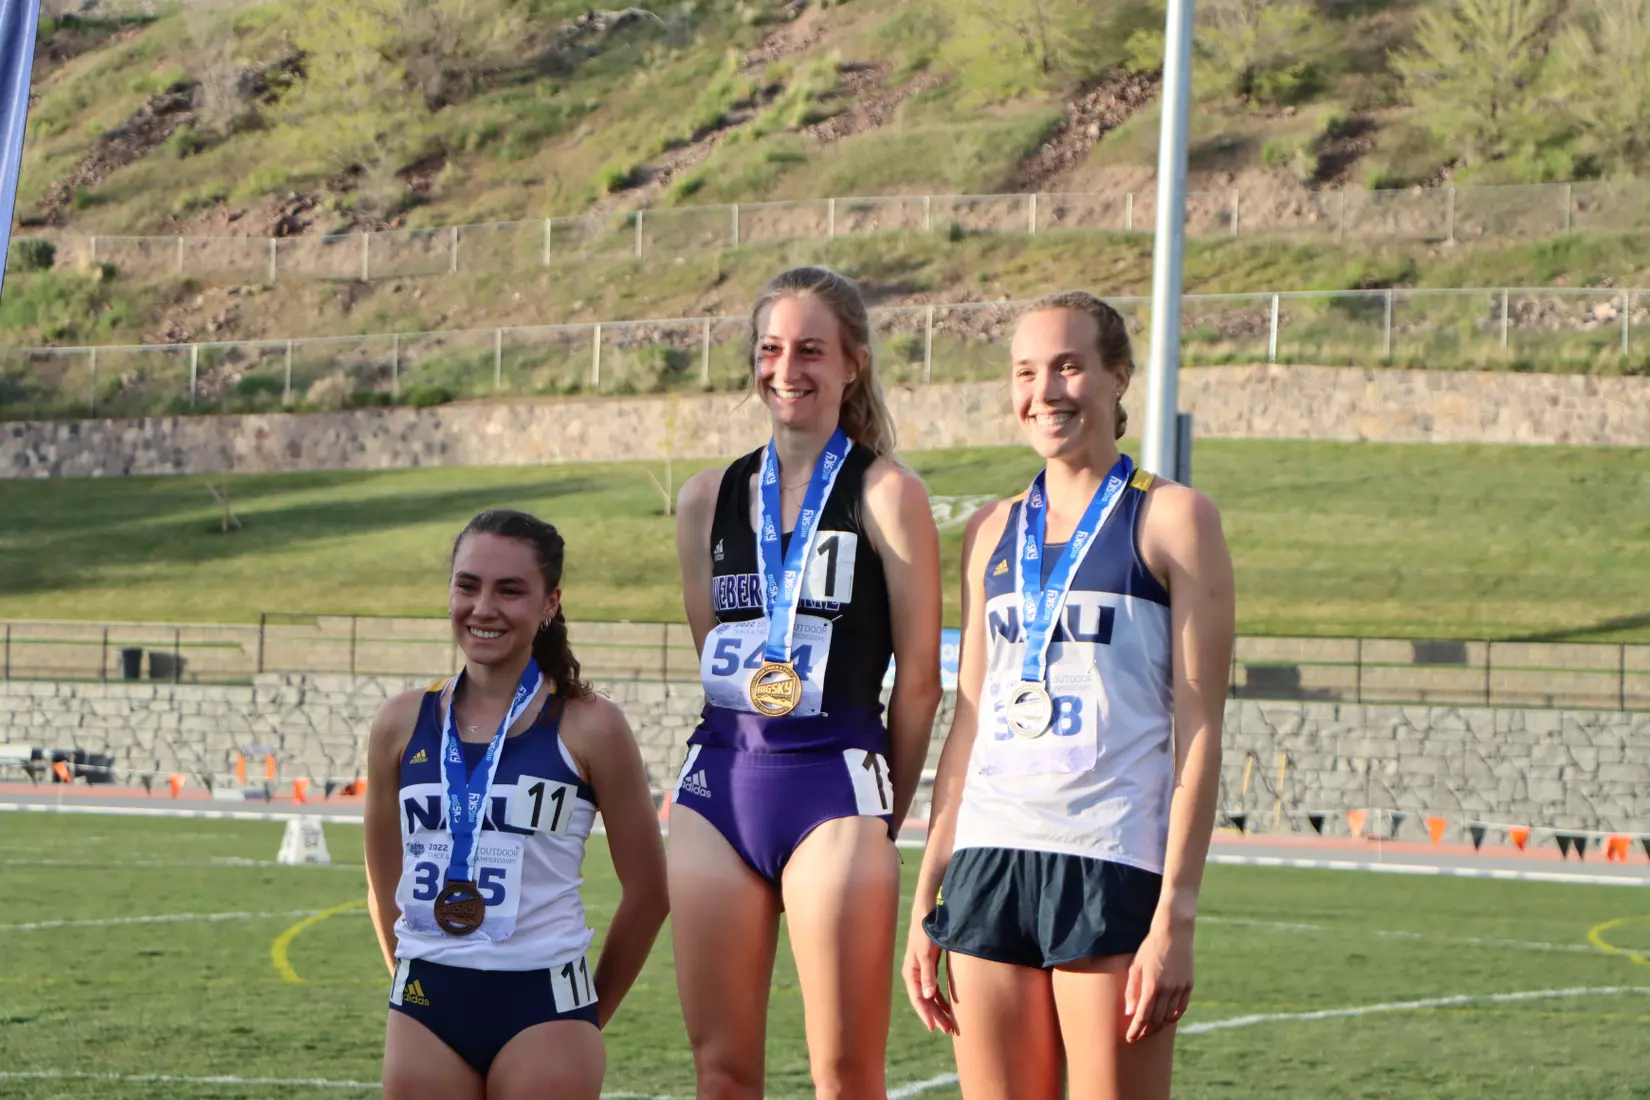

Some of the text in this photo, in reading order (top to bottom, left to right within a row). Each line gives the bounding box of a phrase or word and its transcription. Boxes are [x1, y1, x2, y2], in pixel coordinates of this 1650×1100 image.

[817, 535, 840, 597] 1
[862, 752, 888, 809] 1
[528, 782, 567, 832] 11
[428, 843, 449, 852] 2022
[561, 955, 591, 1007] 11
